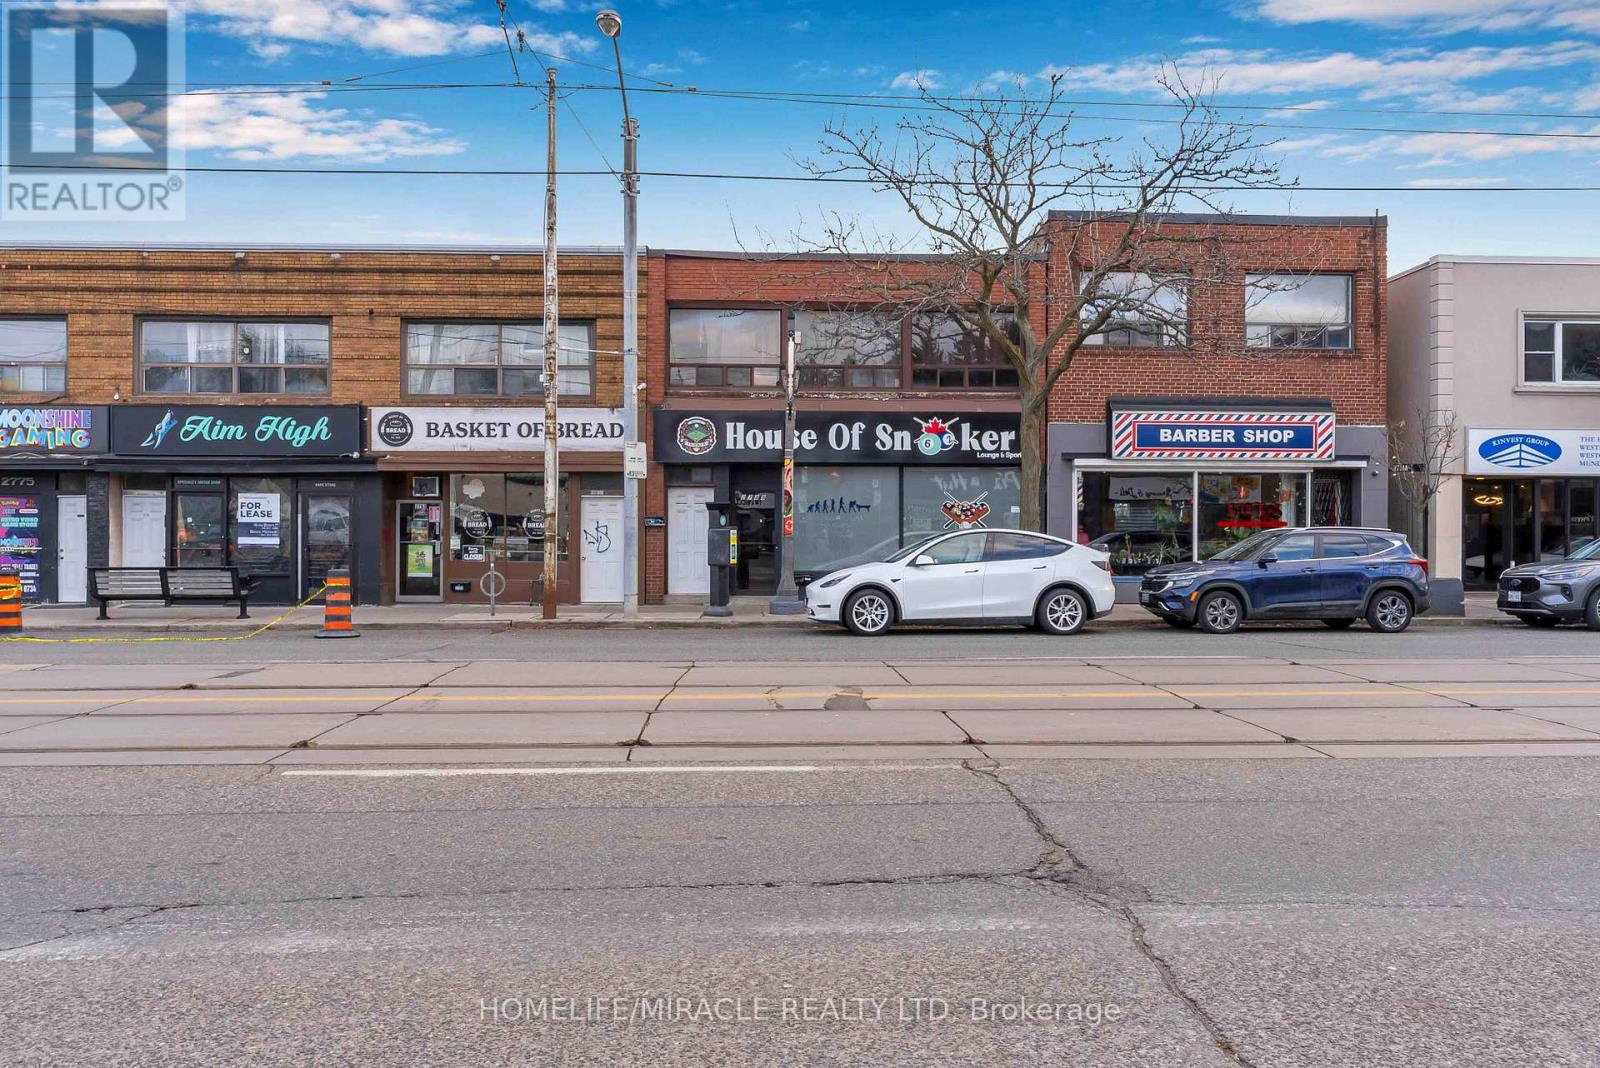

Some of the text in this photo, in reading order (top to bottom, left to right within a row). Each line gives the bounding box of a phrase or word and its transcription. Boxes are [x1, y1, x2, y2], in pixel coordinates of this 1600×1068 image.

[180, 415, 331, 447] Aim High
[426, 422, 511, 438] BASKET
[517, 422, 544, 438] OF
[828, 422, 866, 450] Of
[1159, 428, 1294, 443] BARBER SHOP
[1492, 436, 1550, 447] KINVEST GROUP
[0, 477, 36, 486] 2775
